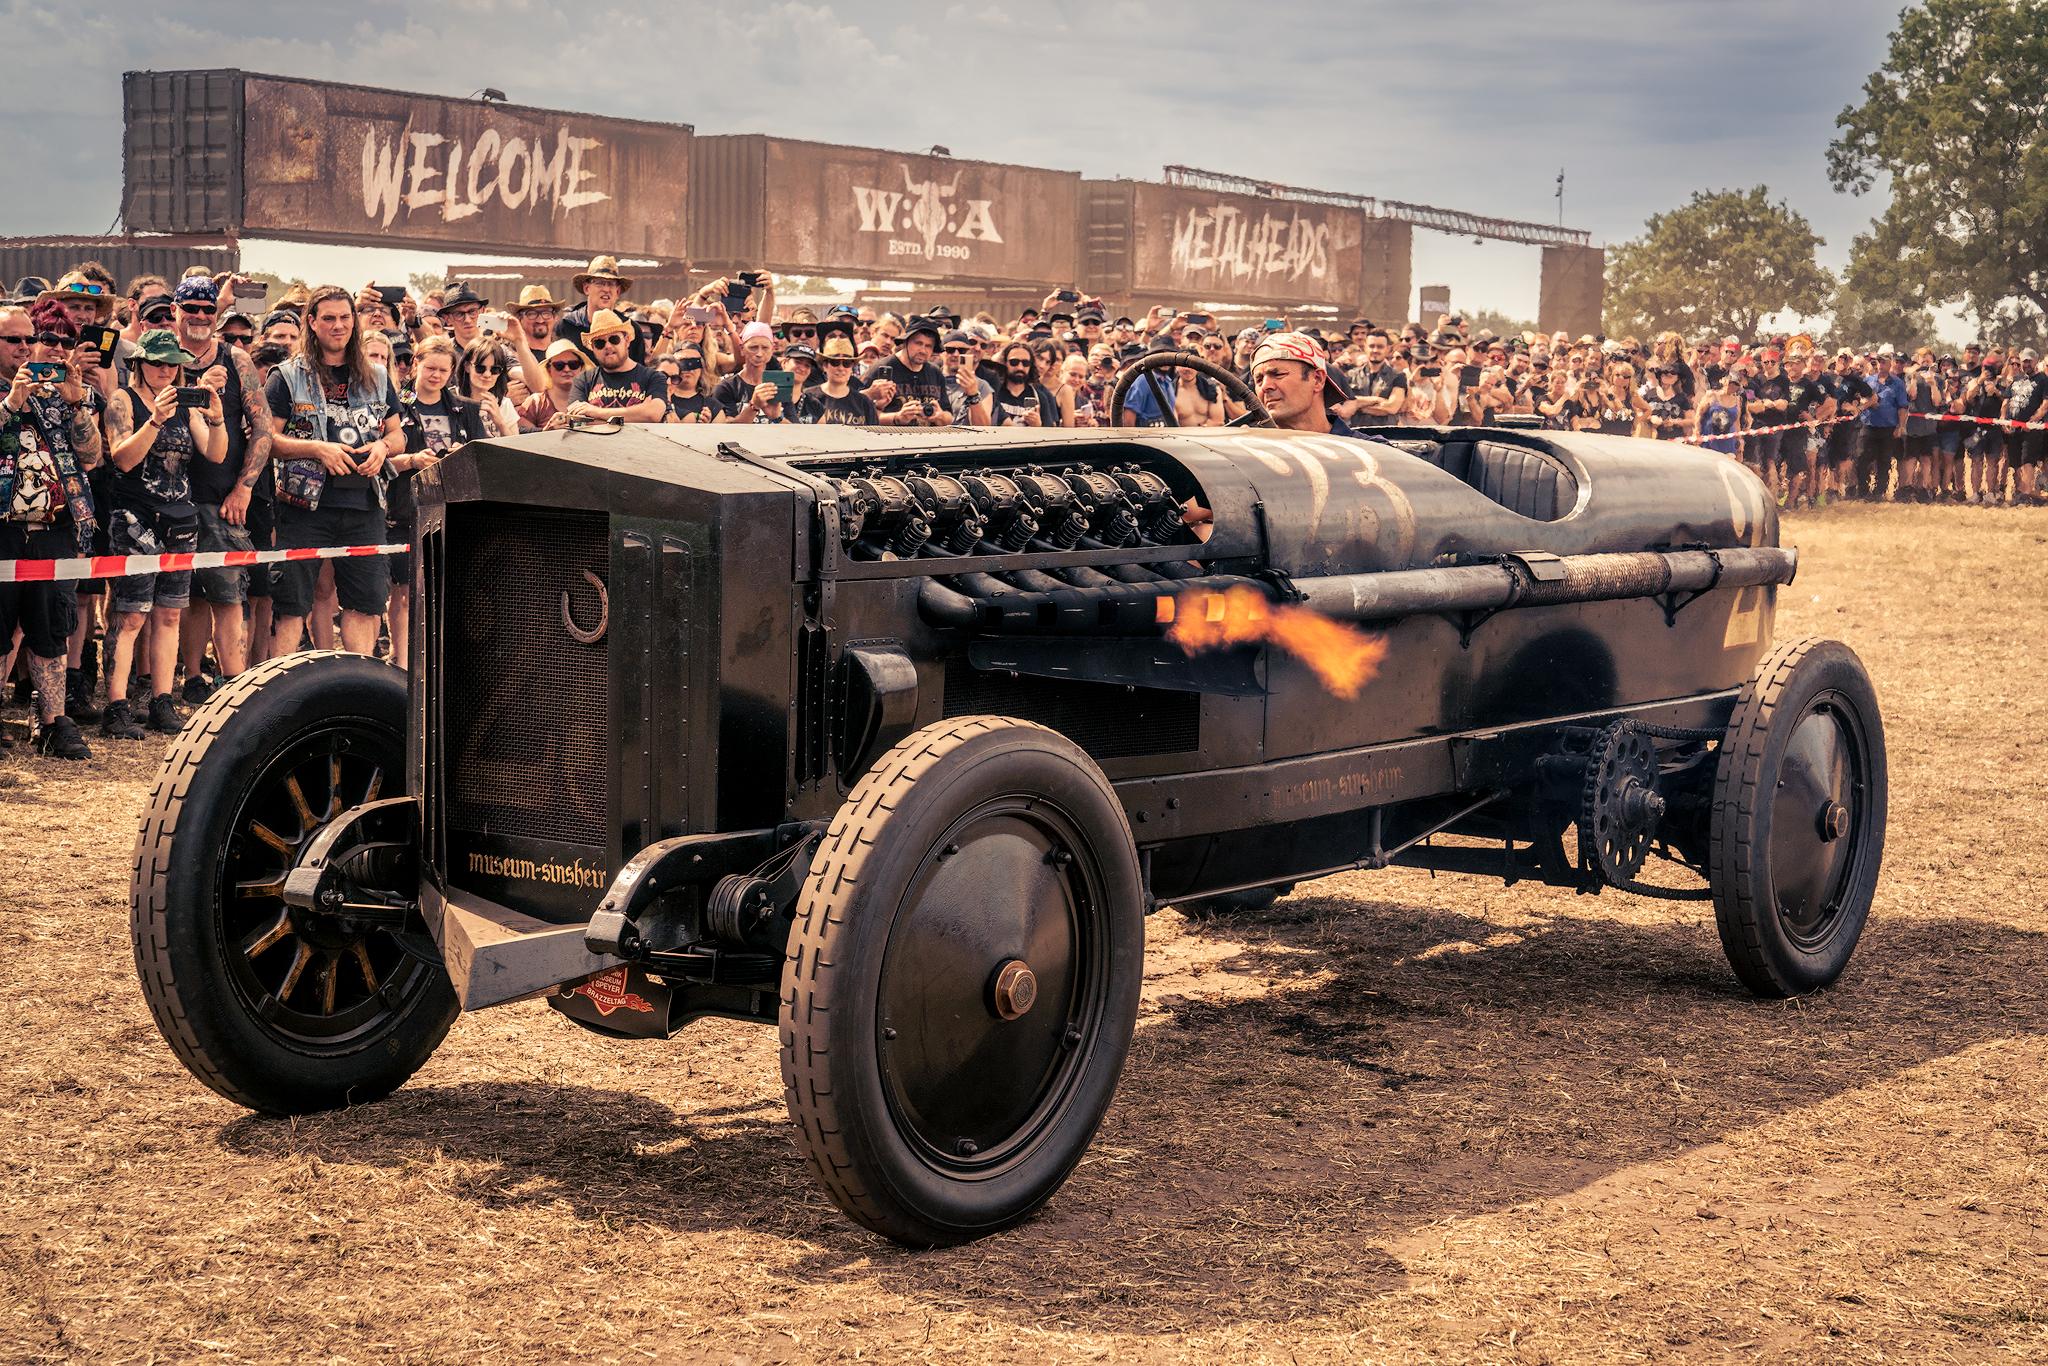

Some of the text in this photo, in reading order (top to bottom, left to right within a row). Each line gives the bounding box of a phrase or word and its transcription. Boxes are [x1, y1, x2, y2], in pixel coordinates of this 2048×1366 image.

[362, 112, 612, 230] WELCOME
[888, 239, 970, 259] ESTD. 1990
[1170, 200, 1329, 286] METALHEADS
[595, 980, 621, 993] SPEYER
[599, 975, 622, 985] USEUM
[586, 987, 626, 1005] BRAZZELTAG
